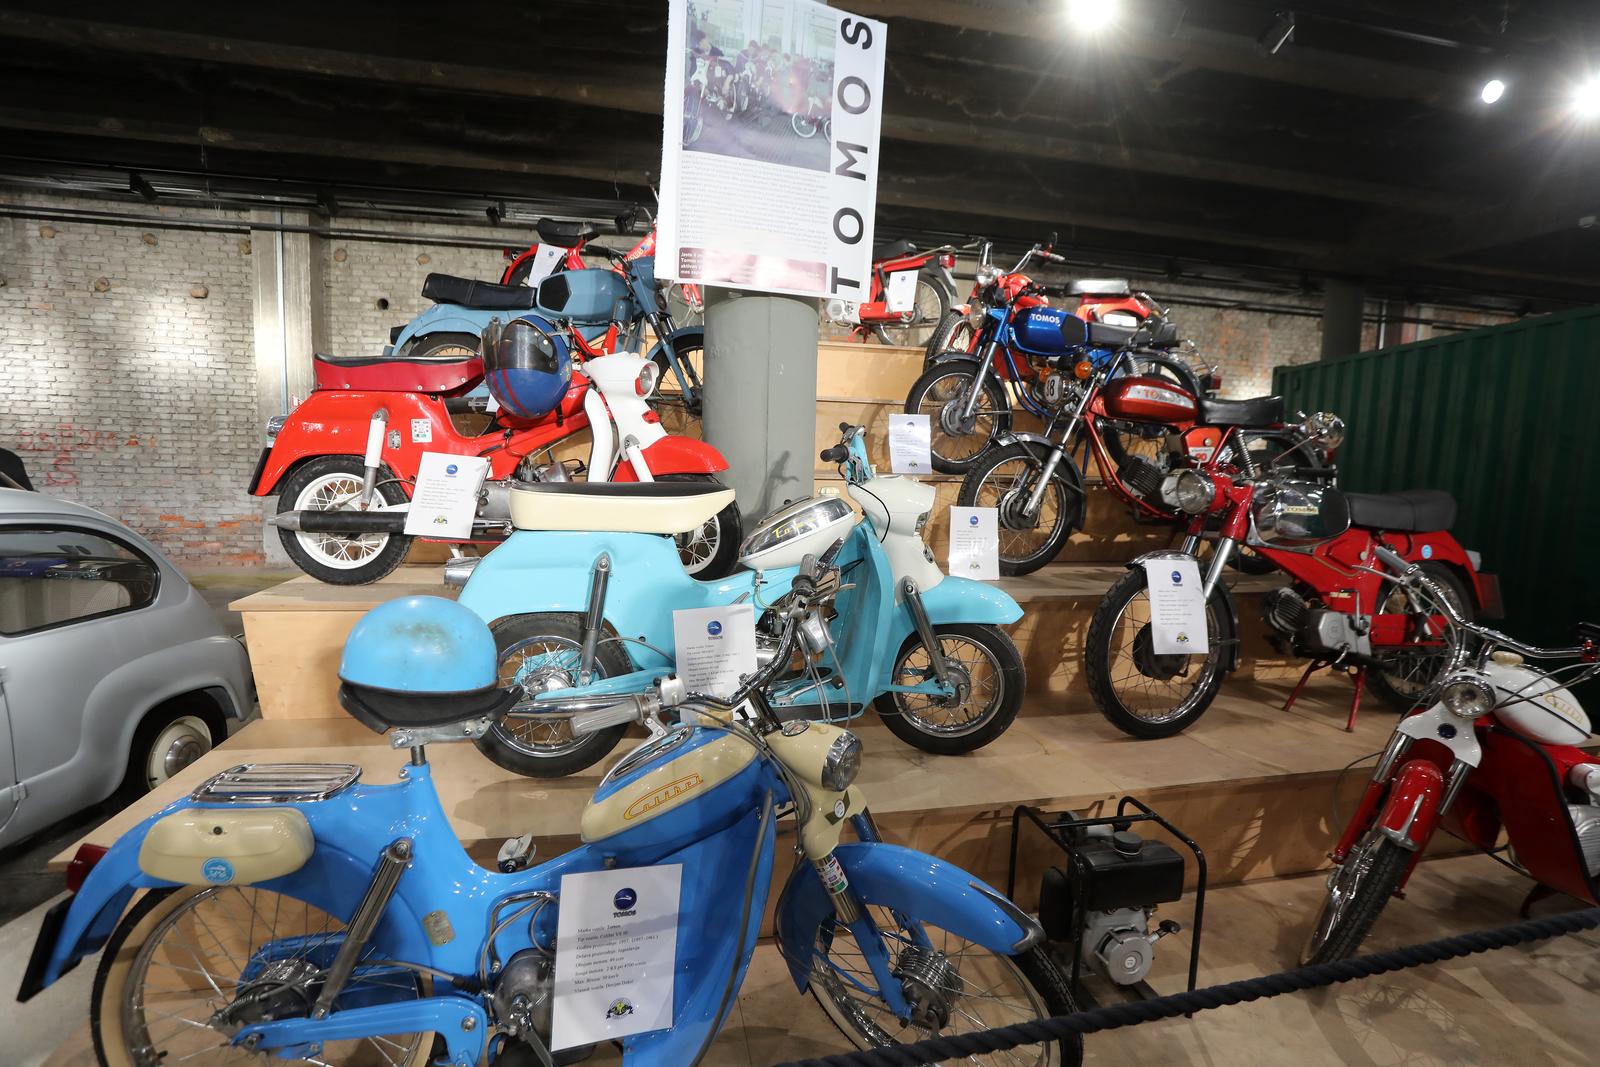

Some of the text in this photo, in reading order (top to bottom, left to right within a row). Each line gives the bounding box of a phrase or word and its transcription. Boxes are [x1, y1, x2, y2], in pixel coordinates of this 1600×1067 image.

[830, 17, 873, 295] TOMOS
[1030, 313, 1060, 324] TOMOS
[613, 909, 637, 919] TOMOS
